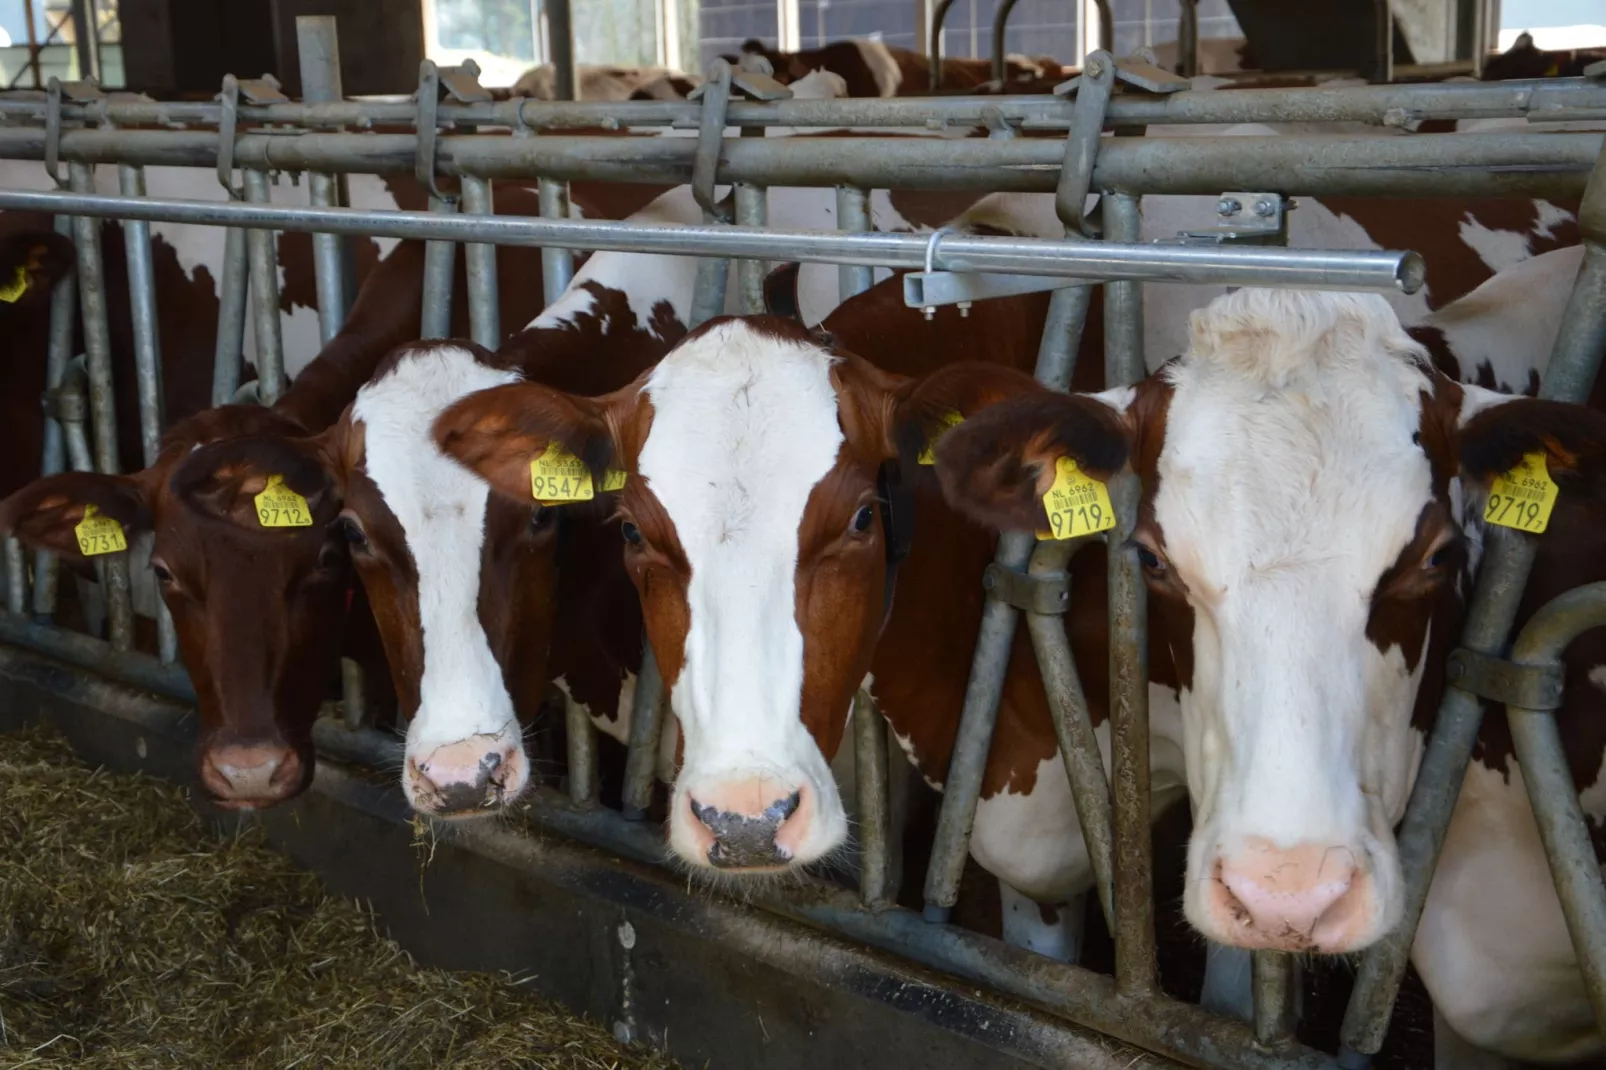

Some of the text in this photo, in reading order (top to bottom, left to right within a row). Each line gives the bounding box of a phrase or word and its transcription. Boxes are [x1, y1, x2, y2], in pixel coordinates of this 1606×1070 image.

[534, 476, 582, 497] 9547
[1052, 482, 1094, 498] NL 6962
[1522, 479, 1547, 490] 6962
[260, 508, 304, 525] 9712
[1051, 503, 1111, 537] 9719 7
[1486, 494, 1543, 530] 9719 7
[80, 533, 120, 553] 9731
